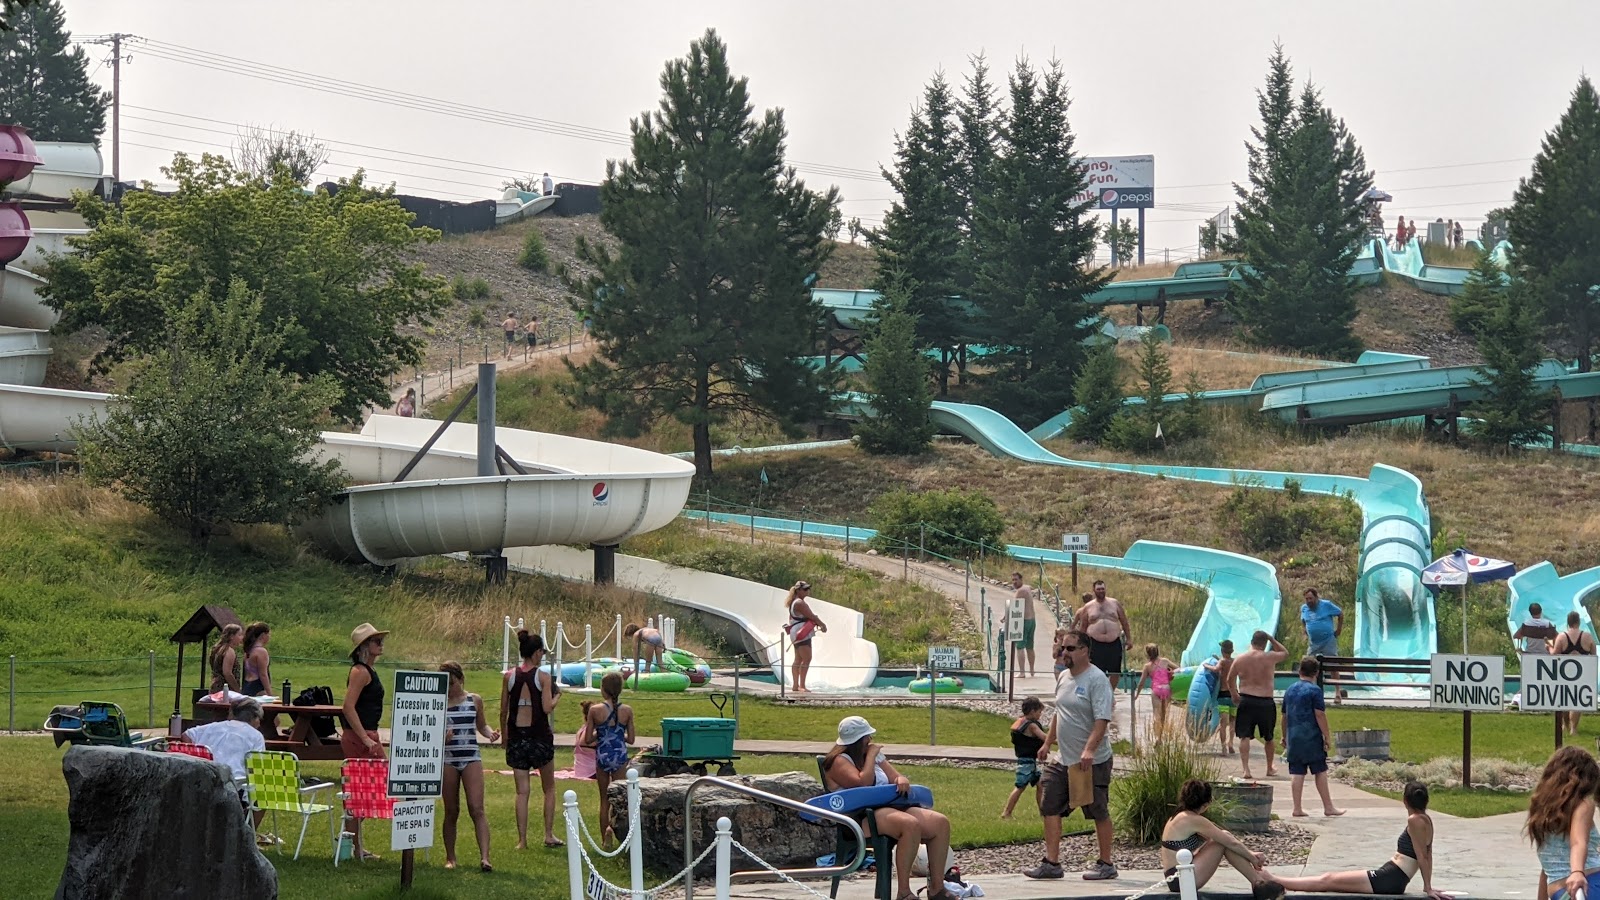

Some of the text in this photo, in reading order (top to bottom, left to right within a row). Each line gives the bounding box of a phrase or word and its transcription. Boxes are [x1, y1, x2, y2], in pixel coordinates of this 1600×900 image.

[1120, 192, 1152, 203] pepsi
[1446, 660, 1489, 682] NO
[1536, 658, 1583, 682] NO
[404, 675, 439, 692] CAUTION
[1434, 684, 1500, 706] RUNNING
[1526, 684, 1593, 708] DIVING
[396, 697, 444, 711] Excessive Use
[402, 714, 437, 727] of Hot Tub
[405, 730, 431, 744] May Be
[395, 745, 439, 758] Hazardous to
[397, 761, 436, 775] your Health
[392, 782, 438, 793] Max Time: 15 min
[393, 804, 434, 817] CAPACITY OF
[396, 819, 430, 831] THE SPA IS
[408, 834, 417, 843] 65
